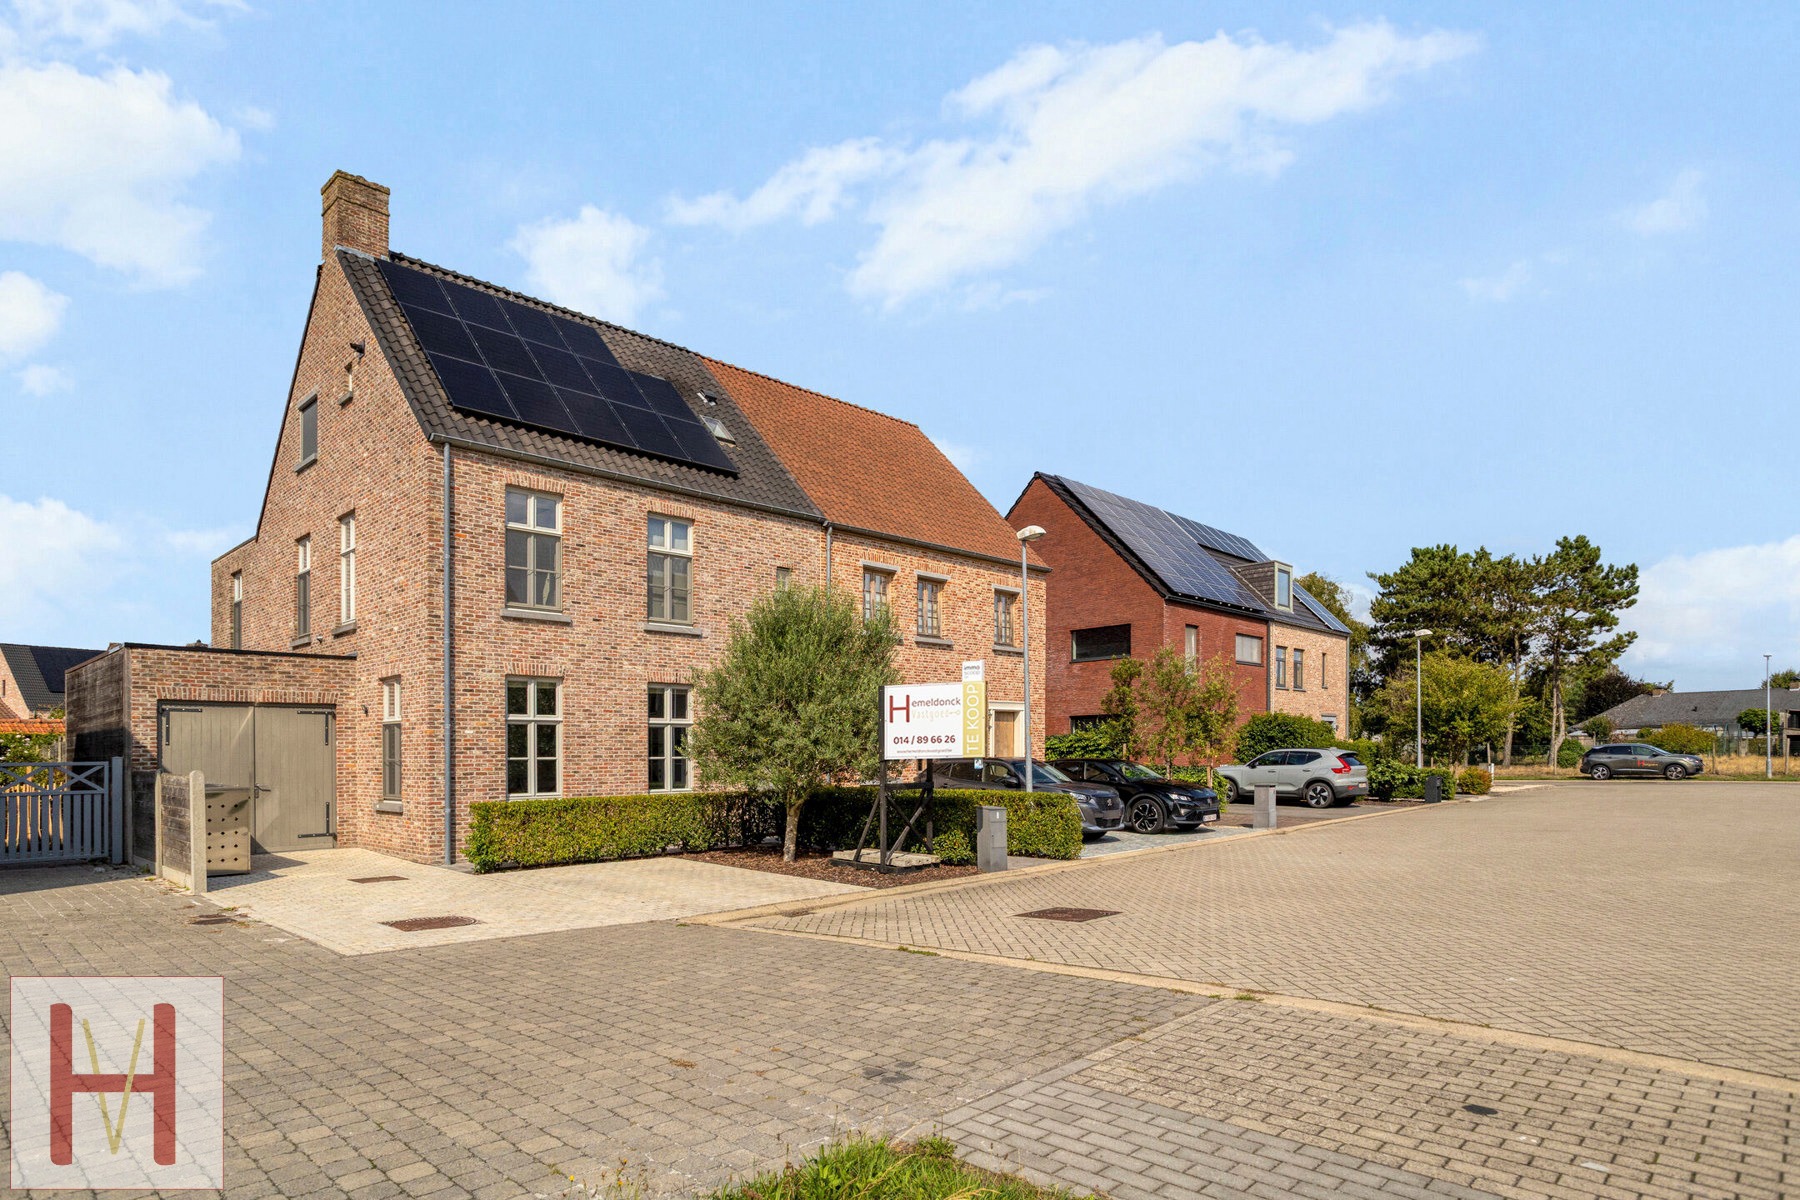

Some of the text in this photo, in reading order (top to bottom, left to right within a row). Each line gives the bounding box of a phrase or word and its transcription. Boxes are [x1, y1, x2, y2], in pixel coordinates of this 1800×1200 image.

[967, 684, 979, 730] KOOP
[893, 735, 956, 745] 014 / 89 66 26
[968, 736, 979, 752] TE
